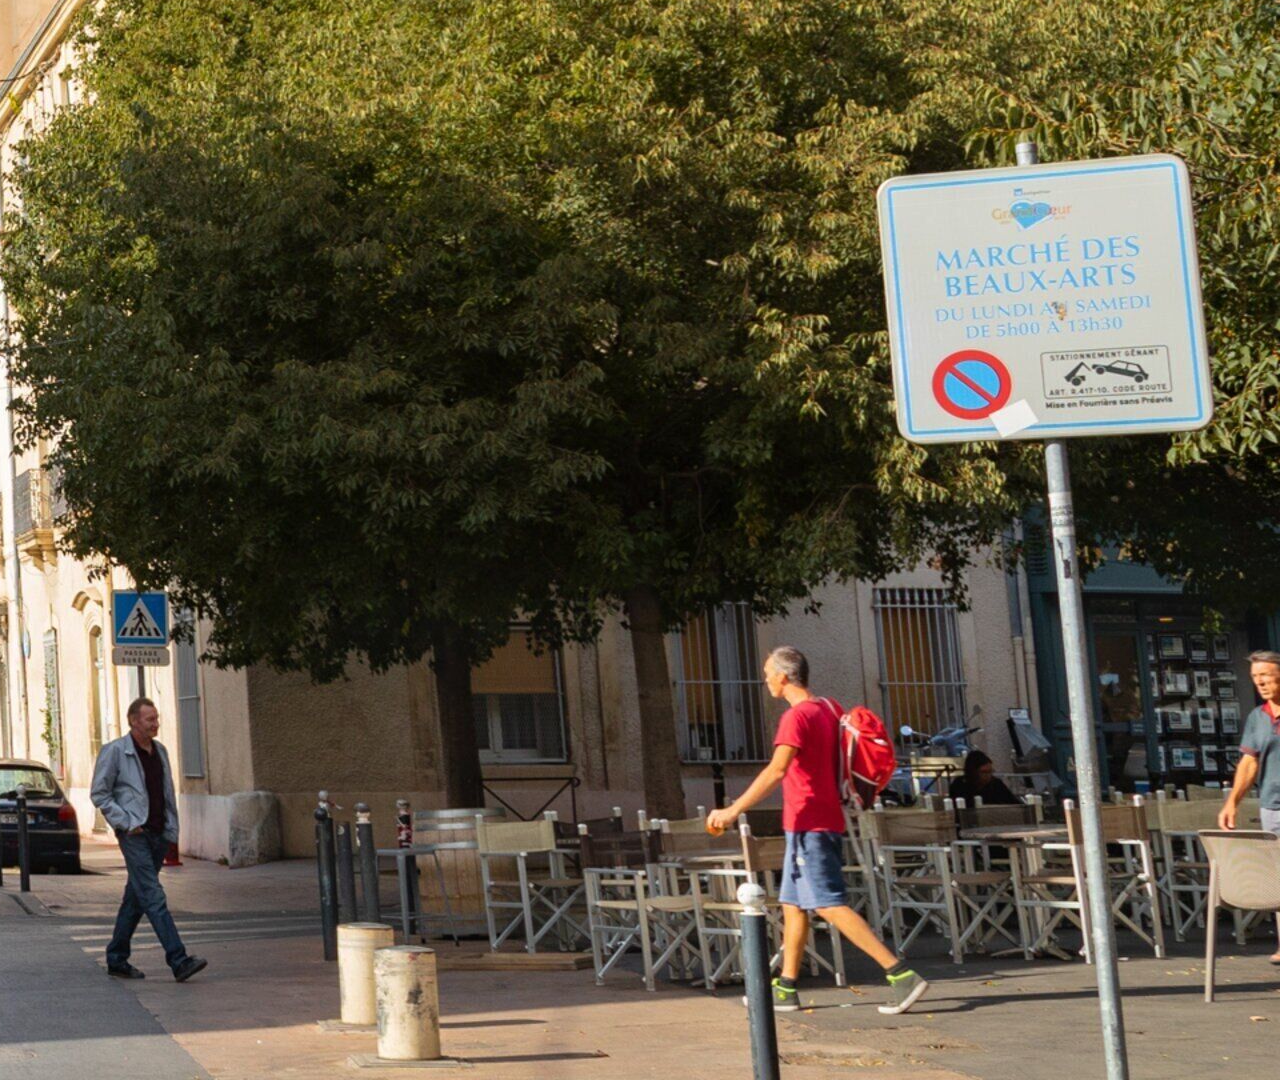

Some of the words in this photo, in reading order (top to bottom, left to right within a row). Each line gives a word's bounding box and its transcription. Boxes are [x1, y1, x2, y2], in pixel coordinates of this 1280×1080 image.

[936, 234, 1070, 271] MARCHÉ
[1082, 235, 1140, 260] DES
[945, 263, 1136, 297] BEAUX-ARTS
[935, 307, 964, 322] DU
[972, 303, 1034, 320] LUNDI
[1076, 295, 1151, 313] SAMEDI
[966, 325, 990, 339] DE
[996, 321, 1040, 337] 5h00
[1069, 316, 1123, 332] 13h30
[1050, 351, 1121, 361] STATIONNEMENT
[1125, 348, 1159, 357] GÊNANT
[1139, 383, 1167, 391] ROUTE
[1045, 401, 1065, 409] Mise
[1079, 398, 1117, 407] Fourrière
[1141, 395, 1173, 404] Préavis
